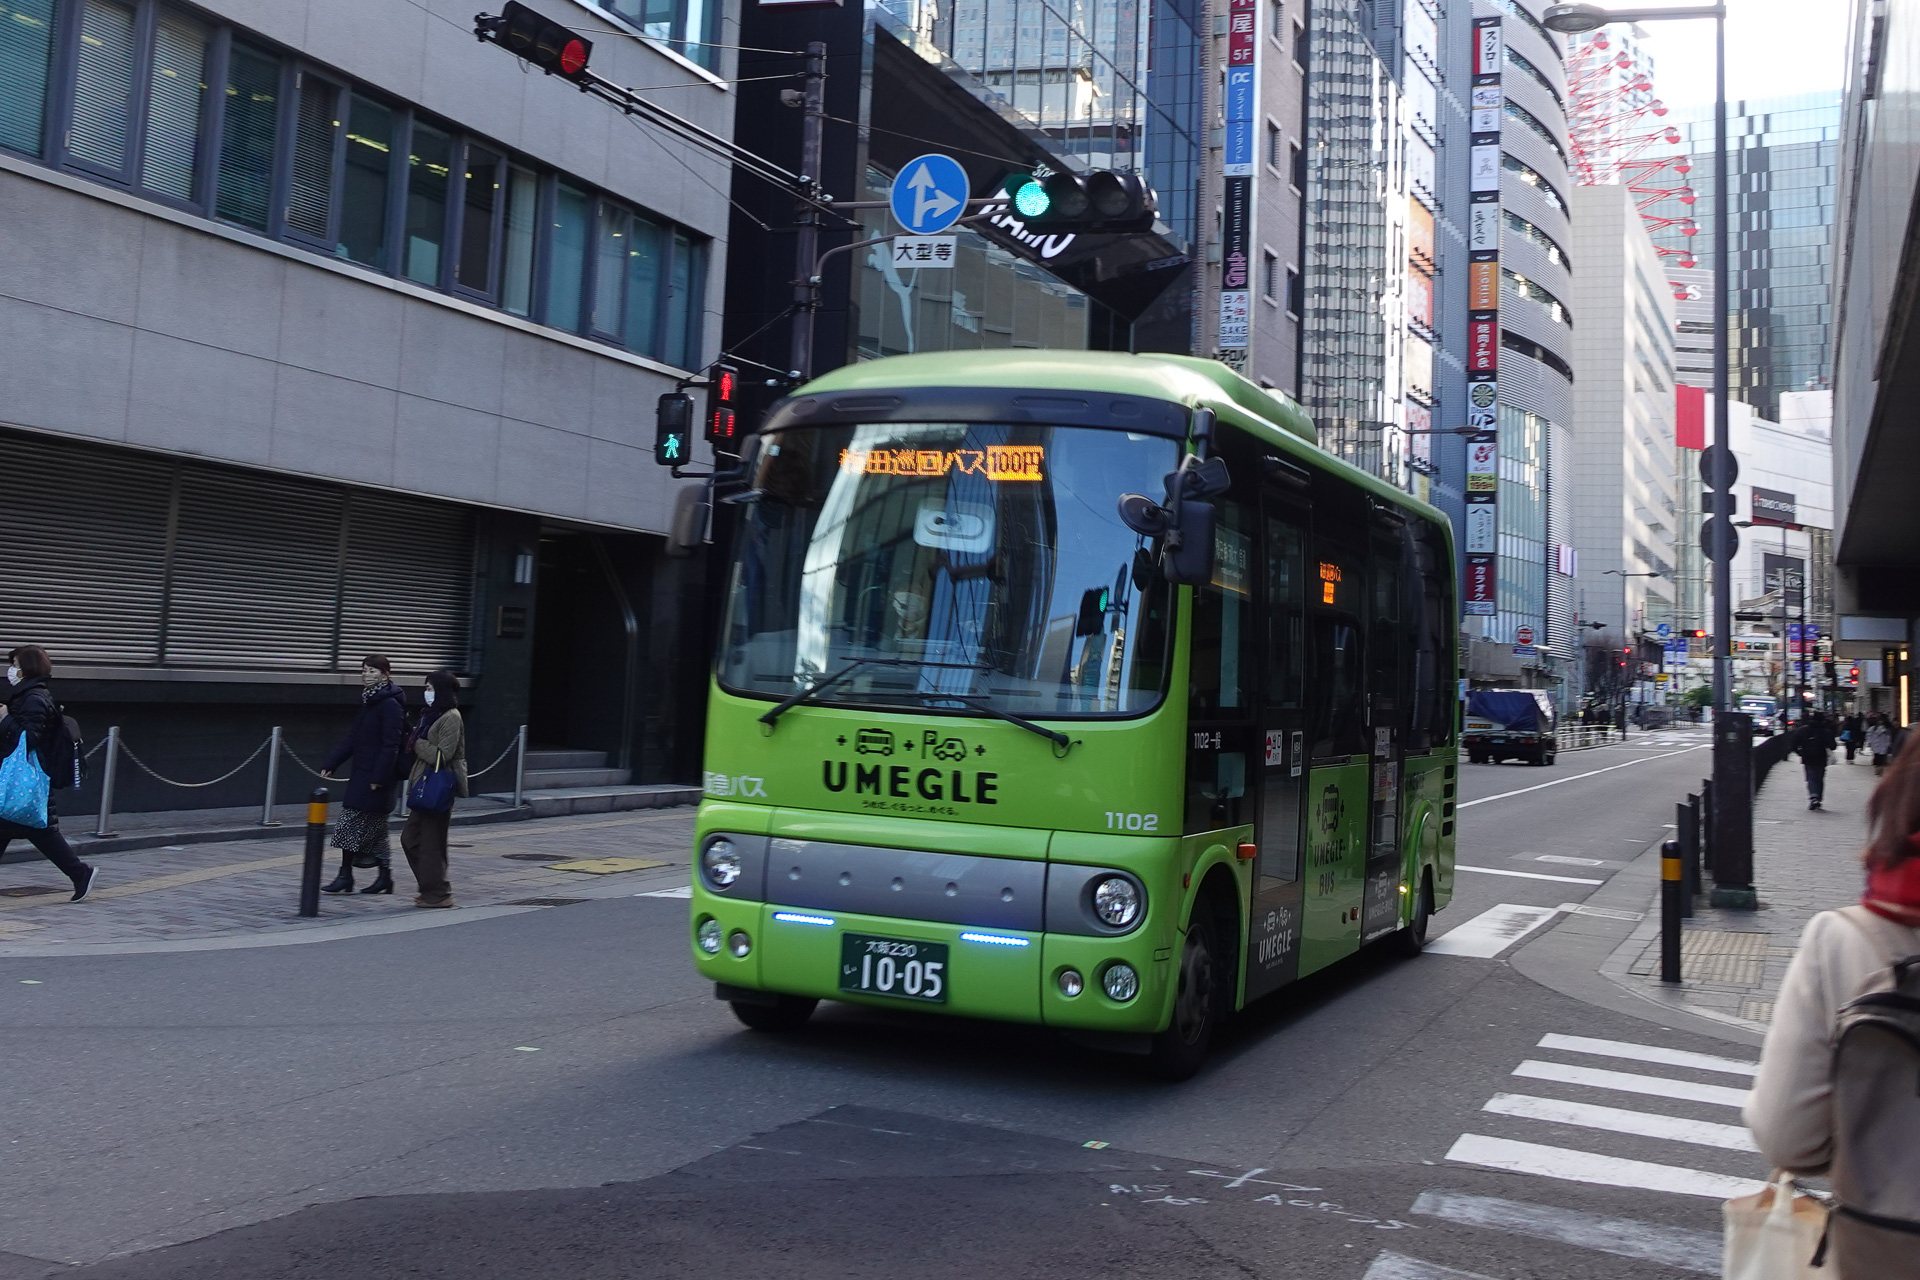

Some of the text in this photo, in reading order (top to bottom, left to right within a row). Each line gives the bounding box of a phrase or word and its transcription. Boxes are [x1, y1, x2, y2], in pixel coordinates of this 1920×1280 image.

[1232, 48, 1252, 61] 5F
[895, 243, 953, 261] 大型等
[1224, 251, 1247, 287] HUB
[1221, 325, 1248, 335] SAKE
[989, 448, 1042, 478] 100円
[822, 760, 998, 805] UMEGLE
[1105, 812, 1158, 831] 1102
[1319, 870, 1335, 896] BUS
[1259, 929, 1292, 963] UMEGLE
[861, 954, 944, 998] 10-05
